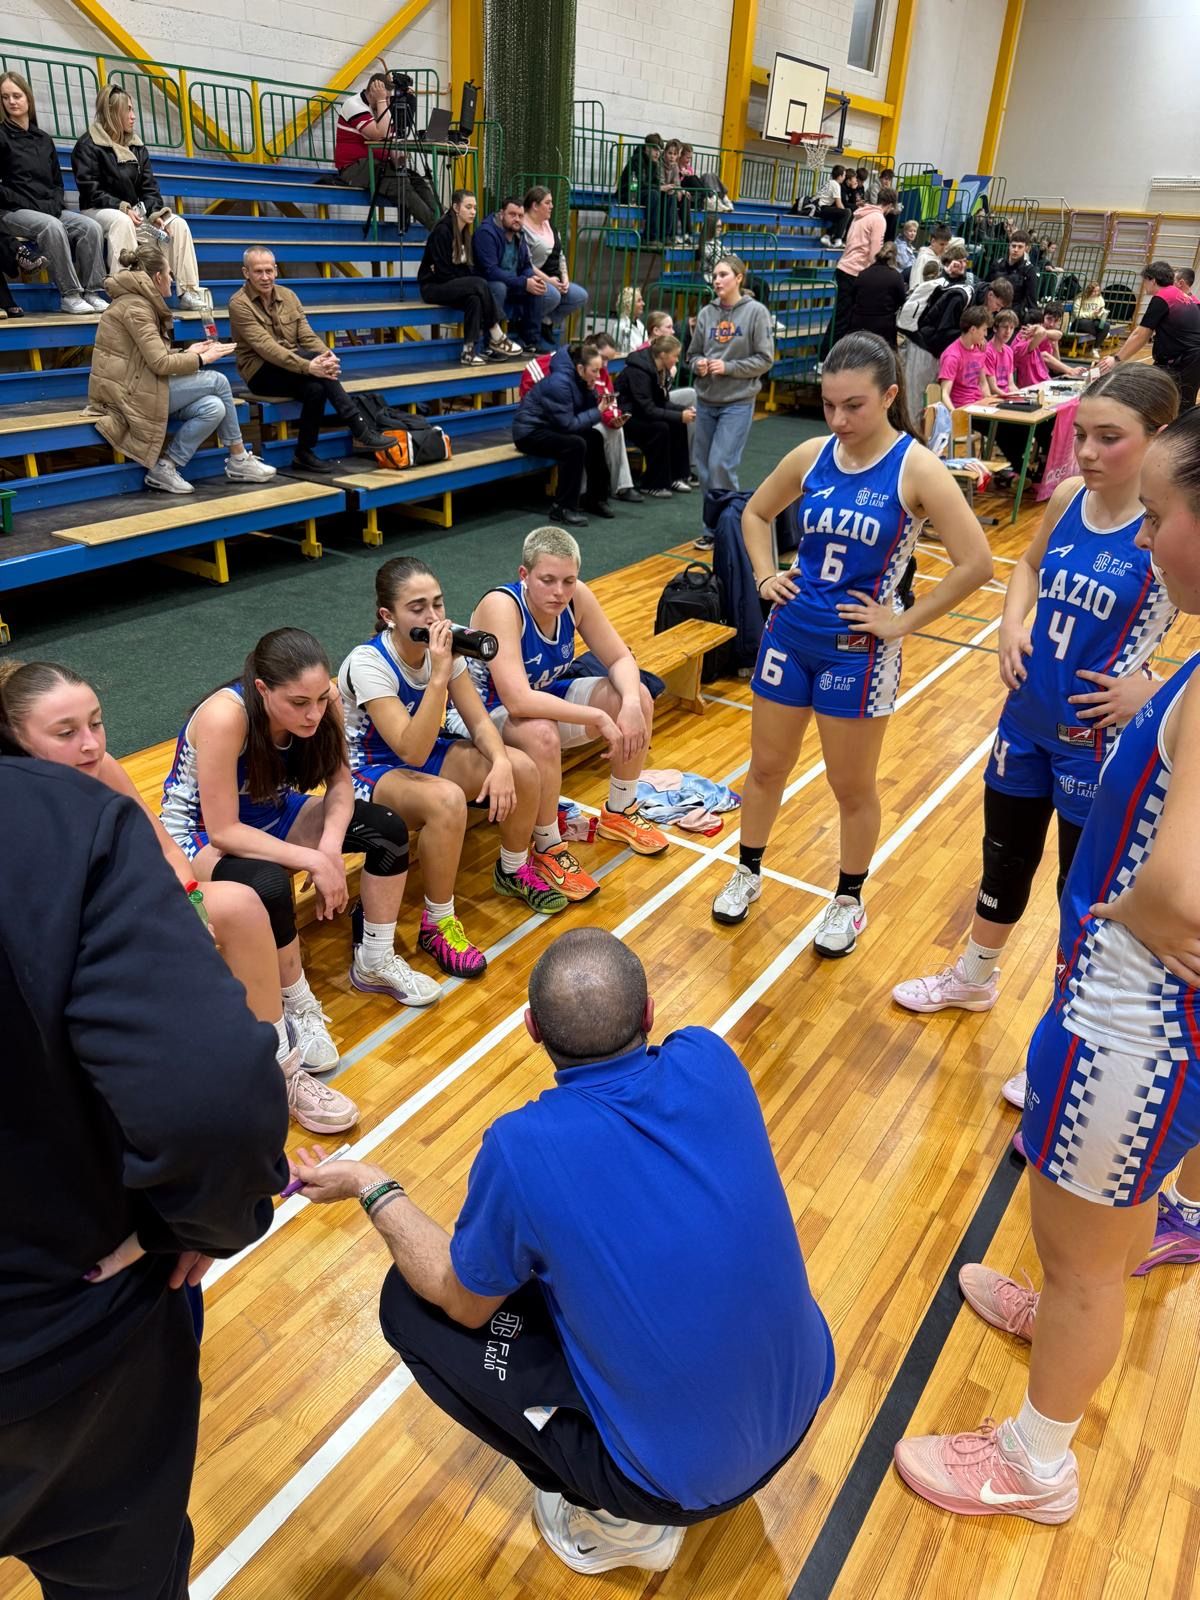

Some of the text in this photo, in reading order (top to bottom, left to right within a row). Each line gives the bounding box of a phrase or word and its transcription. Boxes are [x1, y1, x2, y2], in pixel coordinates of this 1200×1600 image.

[871, 492, 890, 501] FIP
[803, 507, 881, 547] LAZIO
[820, 542, 848, 583] 6
[1107, 566, 1126, 577] LAZIO
[1110, 558, 1133, 570] FIP
[1038, 567, 1117, 621] LAZIO
[1048, 611, 1076, 660] 4
[761, 647, 788, 686] 6
[834, 676, 857, 685] FIP
[833, 683, 851, 691] LAZIO
[993, 733, 1011, 777] 4
[982, 893, 999, 910] NBA
[484, 1340, 498, 1371] LAZIO
[495, 1342, 510, 1381] FIP
